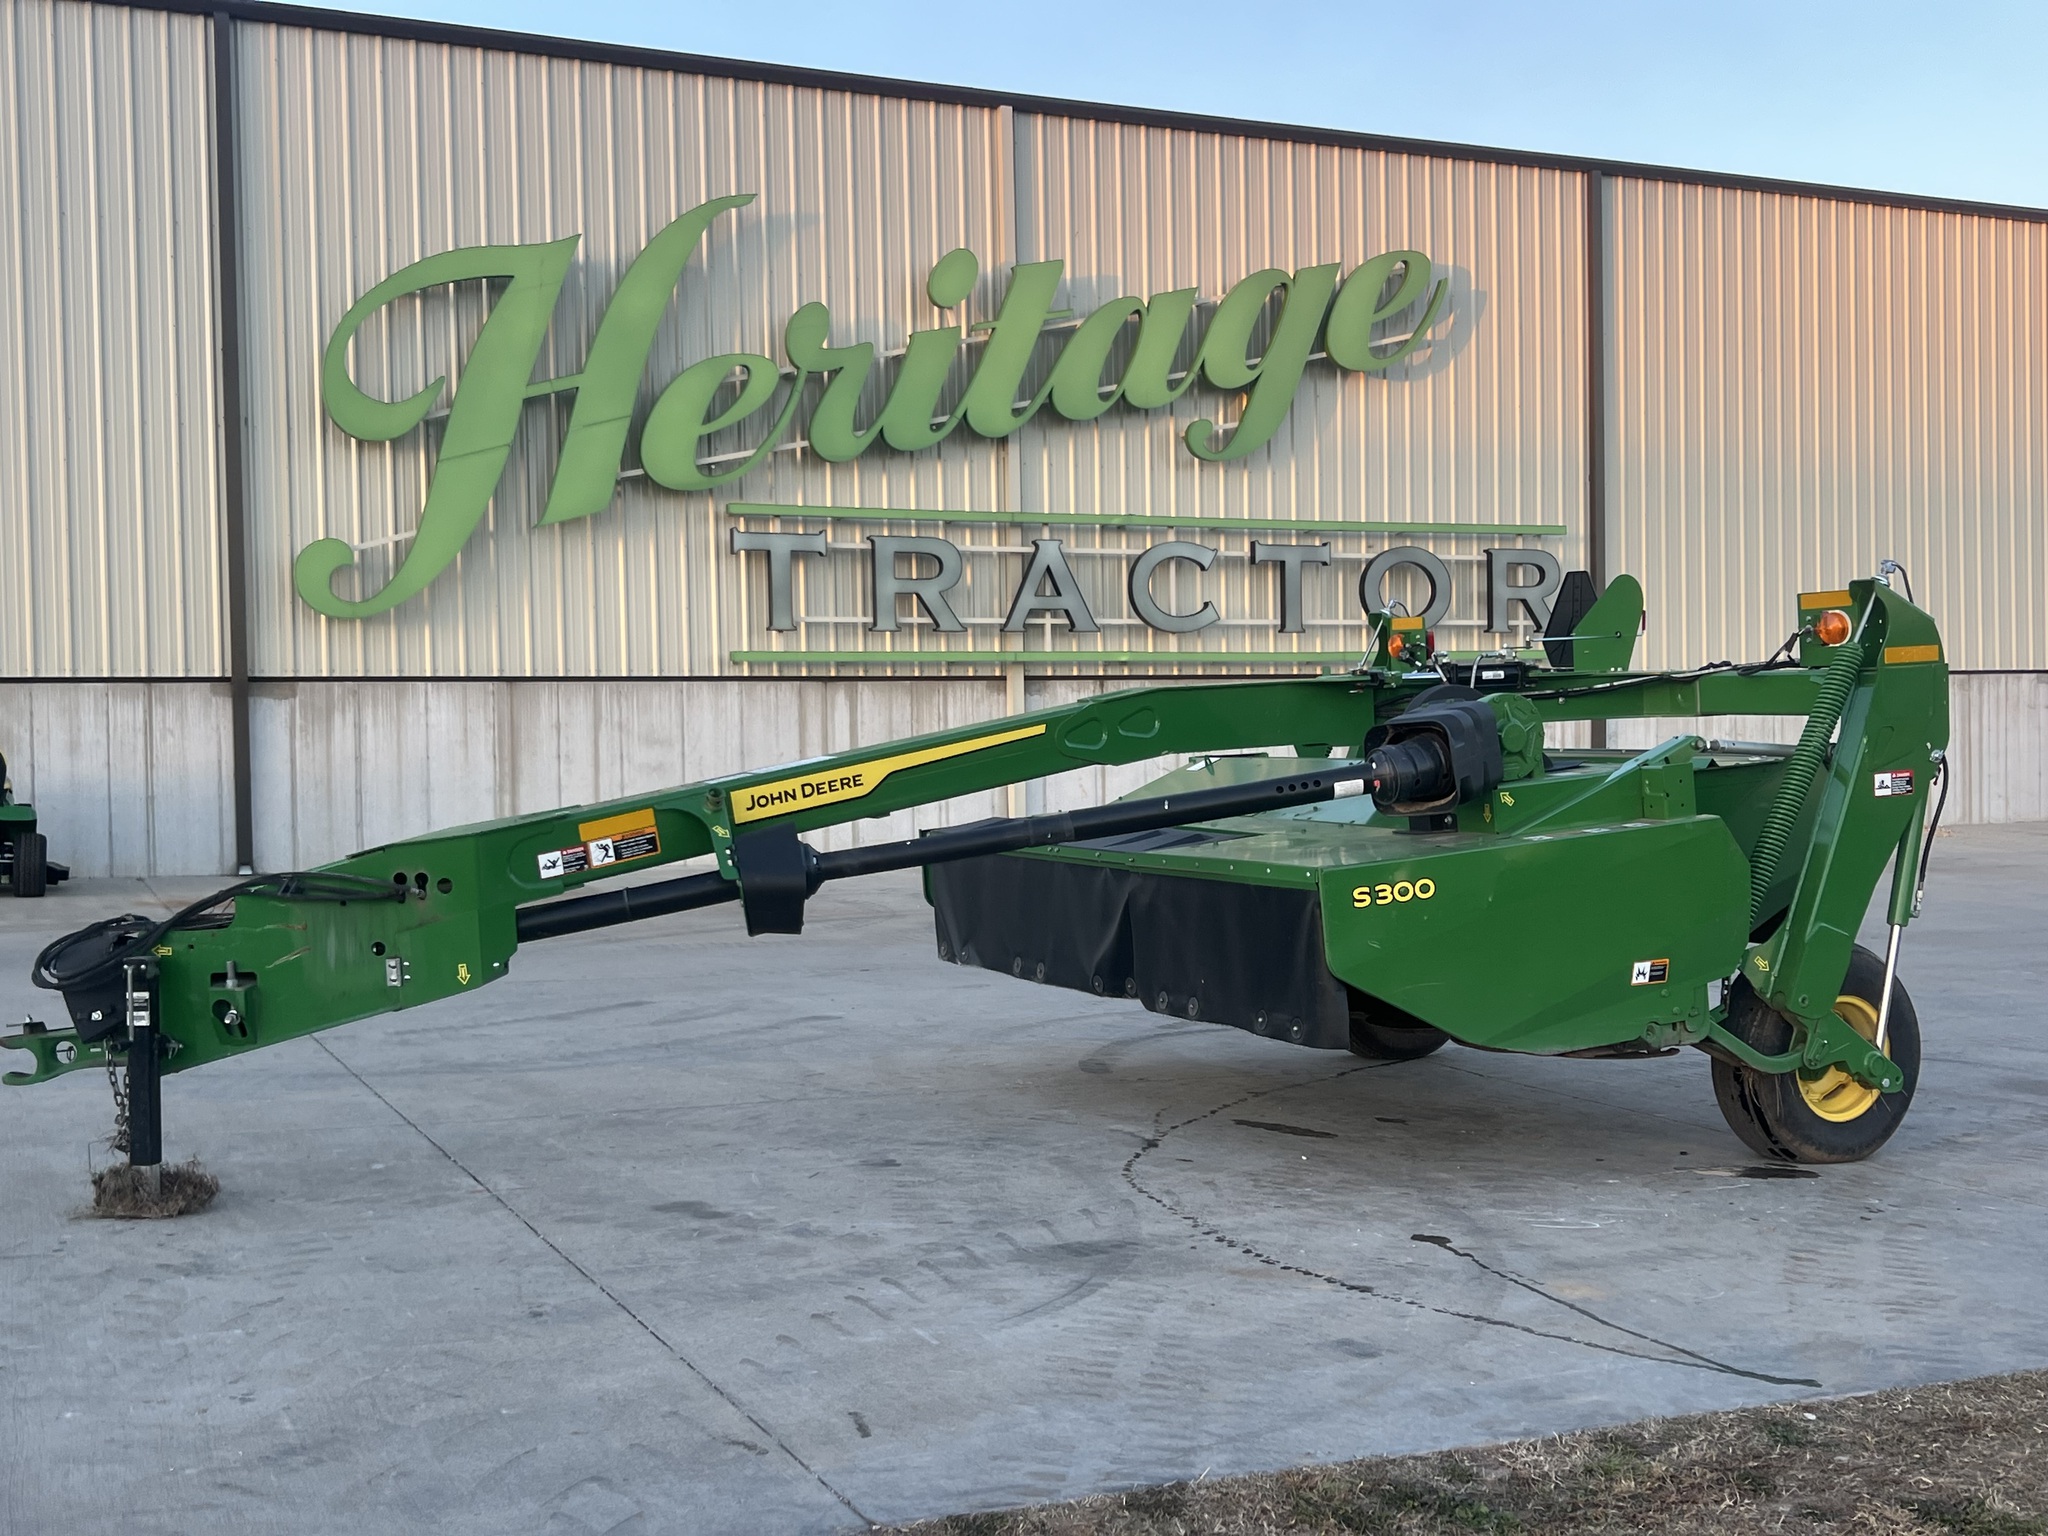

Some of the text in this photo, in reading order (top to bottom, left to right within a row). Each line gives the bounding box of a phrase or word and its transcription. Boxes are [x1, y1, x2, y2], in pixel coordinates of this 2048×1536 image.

[293, 194, 1449, 619] Heritage
[730, 528, 1566, 636] TRACTOR
[745, 774, 864, 812] JOHN DEERE
